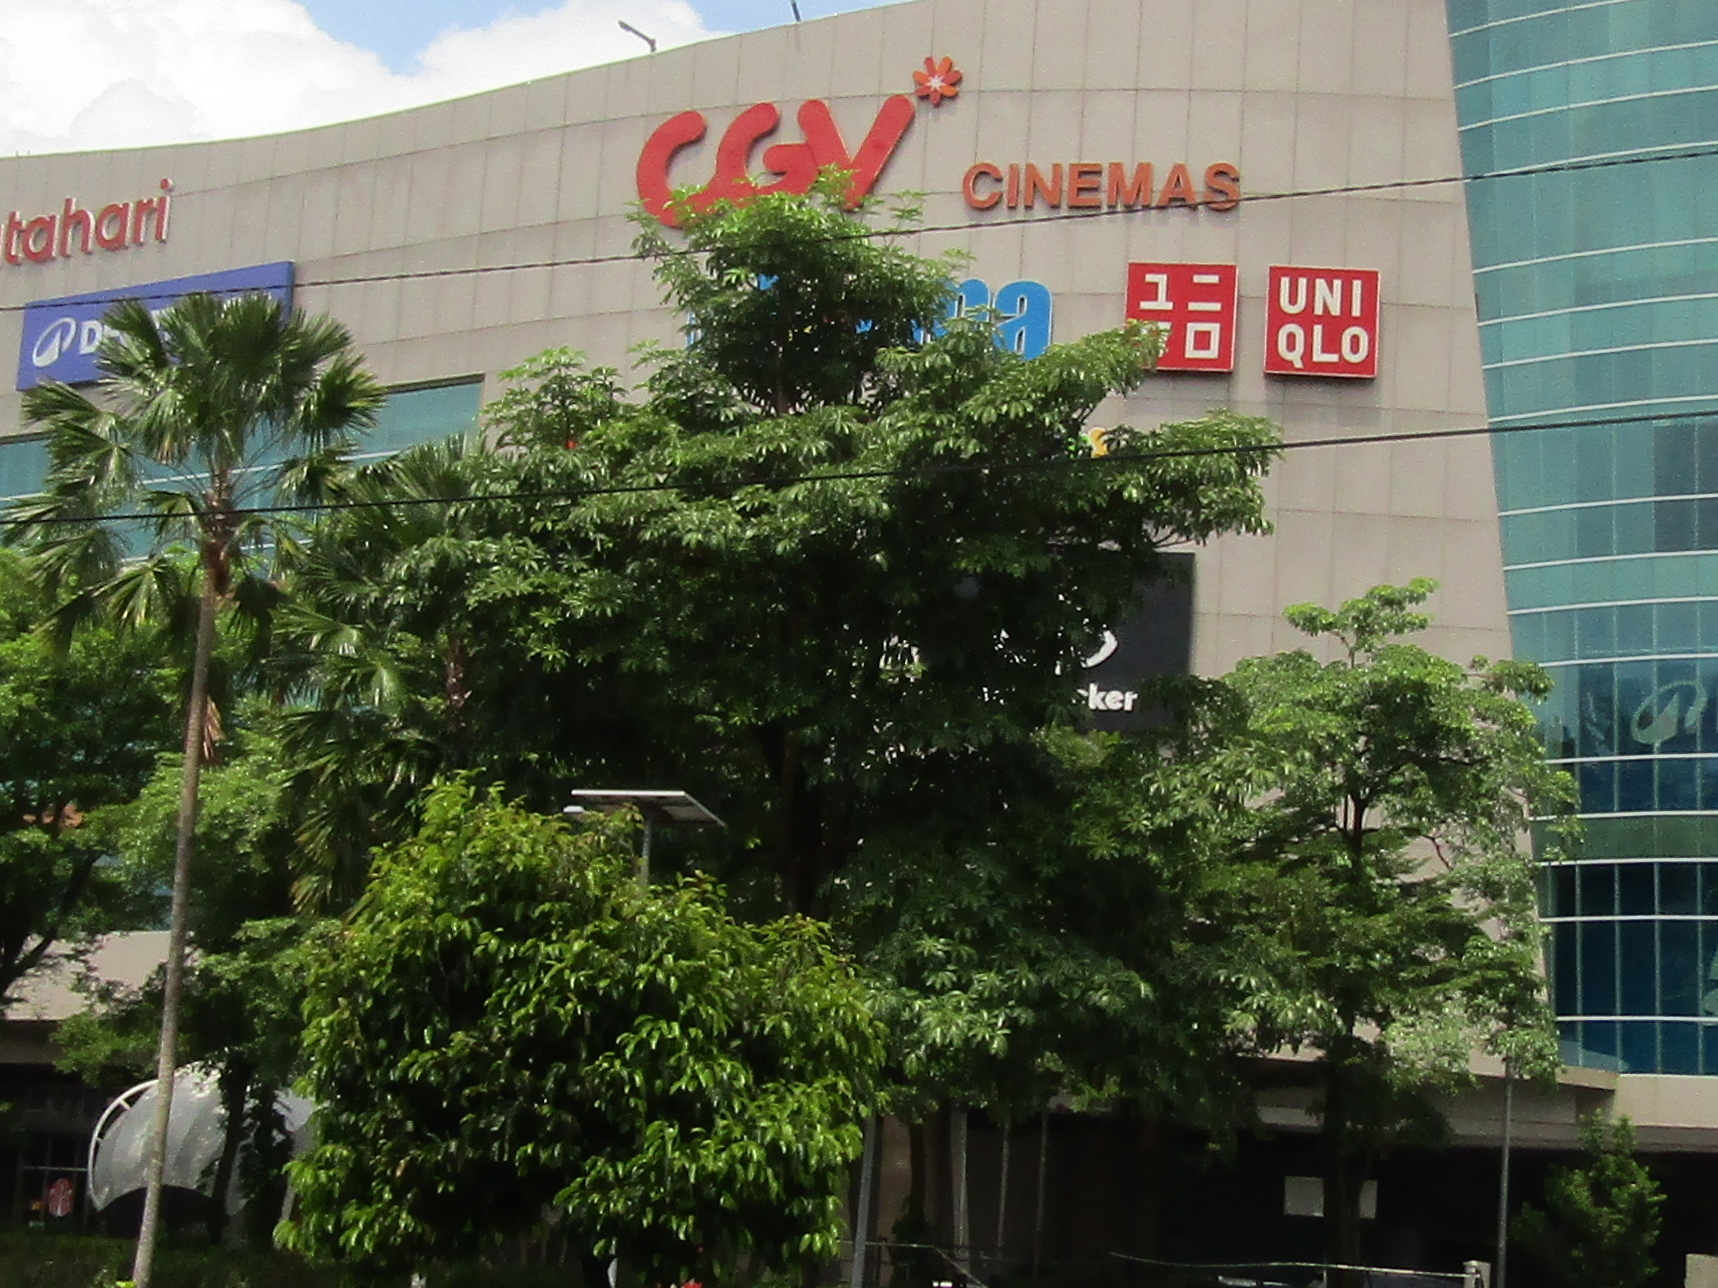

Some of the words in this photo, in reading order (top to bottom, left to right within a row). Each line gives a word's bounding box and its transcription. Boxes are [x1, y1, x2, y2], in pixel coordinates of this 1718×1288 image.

[635, 93, 916, 229] CGV
[961, 162, 1241, 212] CINEMAS
[1279, 275, 1363, 318] UNI
[1276, 324, 1371, 369] QLO
